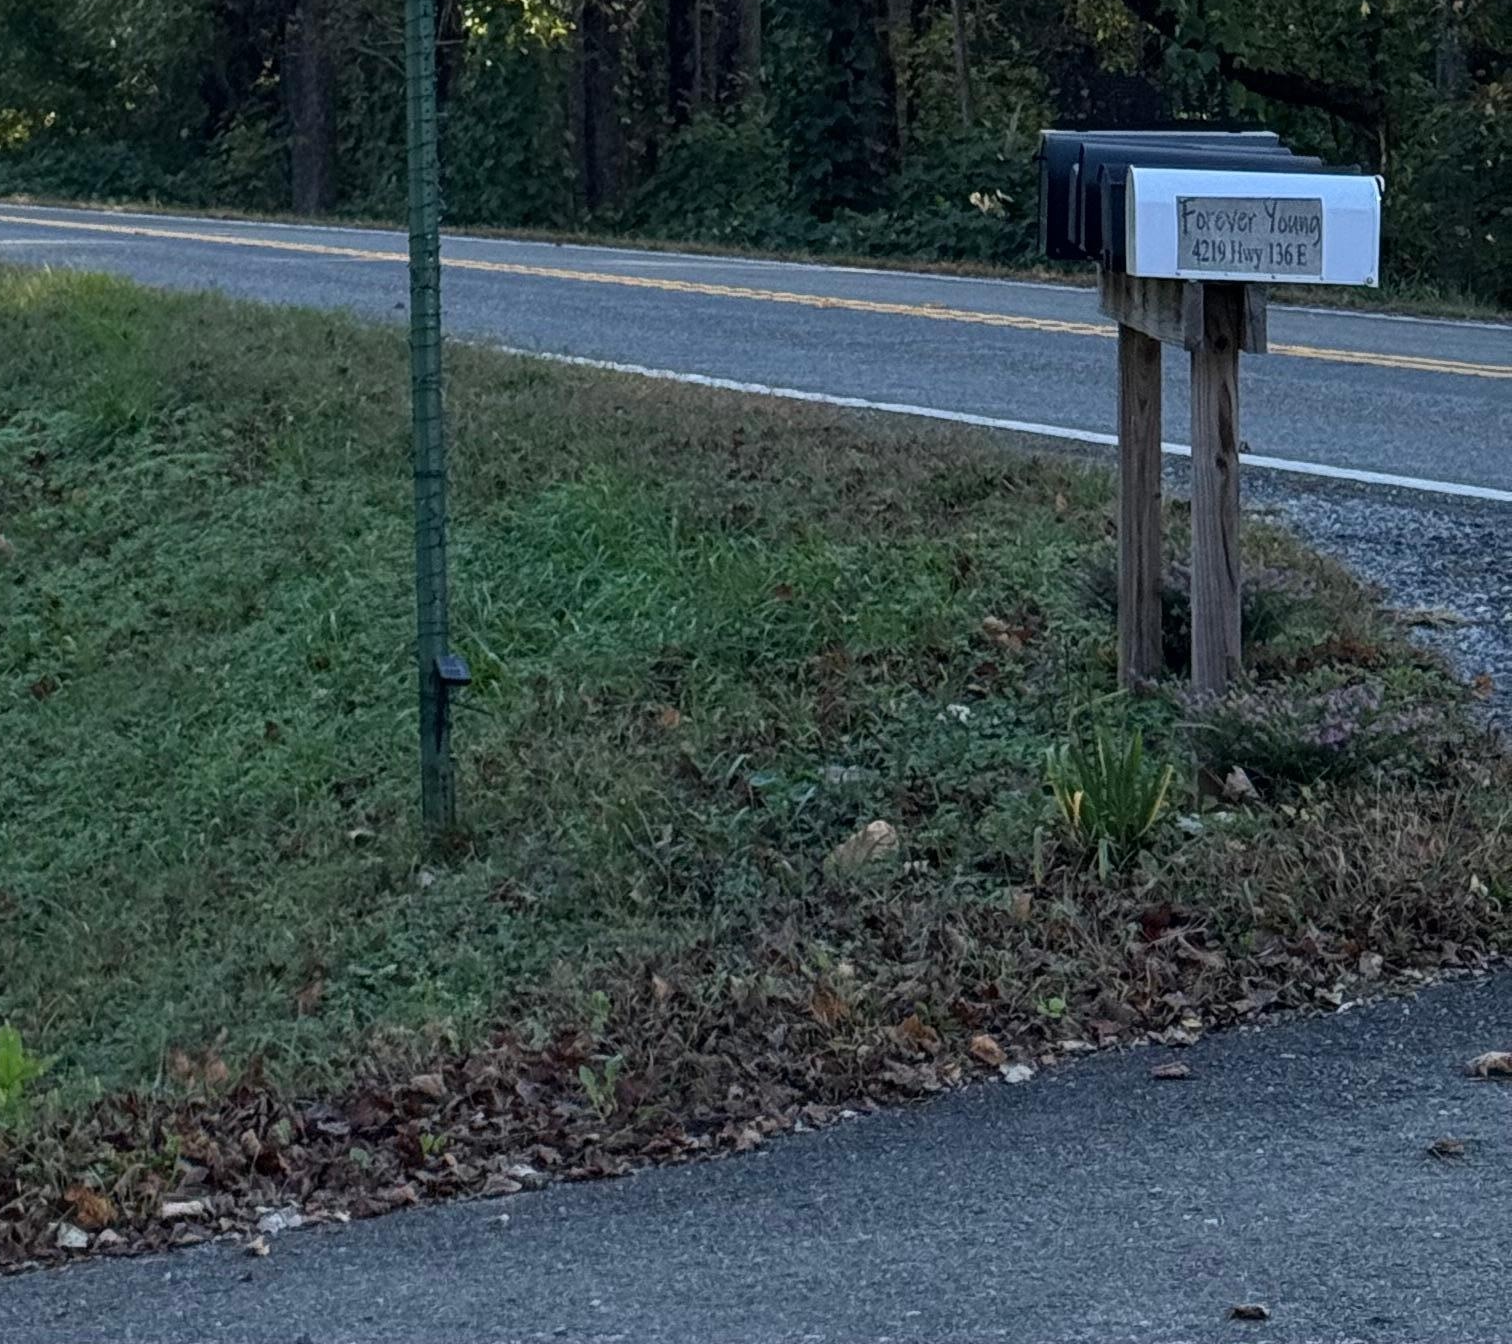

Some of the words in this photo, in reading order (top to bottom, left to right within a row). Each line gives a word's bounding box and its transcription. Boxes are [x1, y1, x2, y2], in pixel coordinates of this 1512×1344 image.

[1179, 198, 1257, 235] Forever
[1263, 198, 1321, 247] Young
[1191, 237, 1226, 262] 4219
[1230, 239, 1264, 270] Hwy
[1268, 242, 1293, 266] 136
[1297, 243, 1308, 266] E
